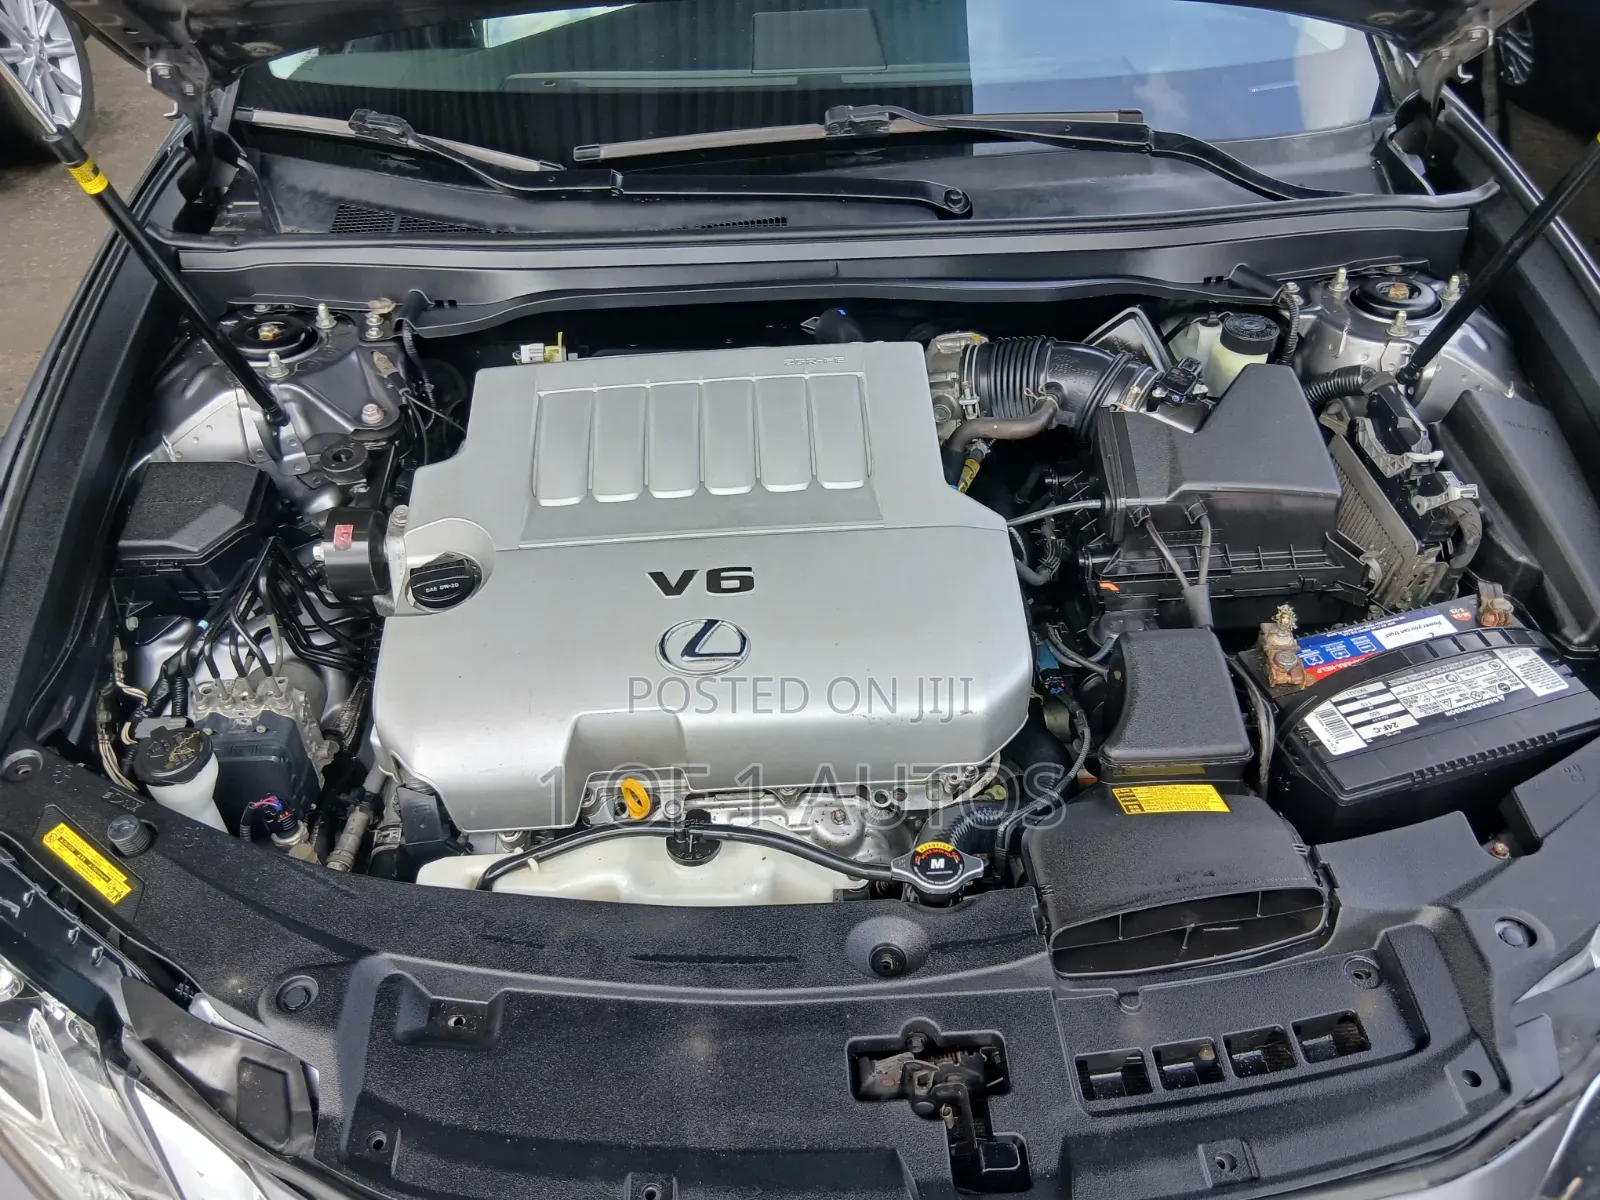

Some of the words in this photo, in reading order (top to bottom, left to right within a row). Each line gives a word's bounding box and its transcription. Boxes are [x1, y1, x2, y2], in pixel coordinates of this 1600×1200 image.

[439, 582, 460, 590] 0W-20
[645, 566, 755, 599] V6
[1401, 627, 1411, 635] can
[1411, 624, 1423, 632] you
[1373, 722, 1399, 734] 24F-C
[931, 858, 945, 869] M
